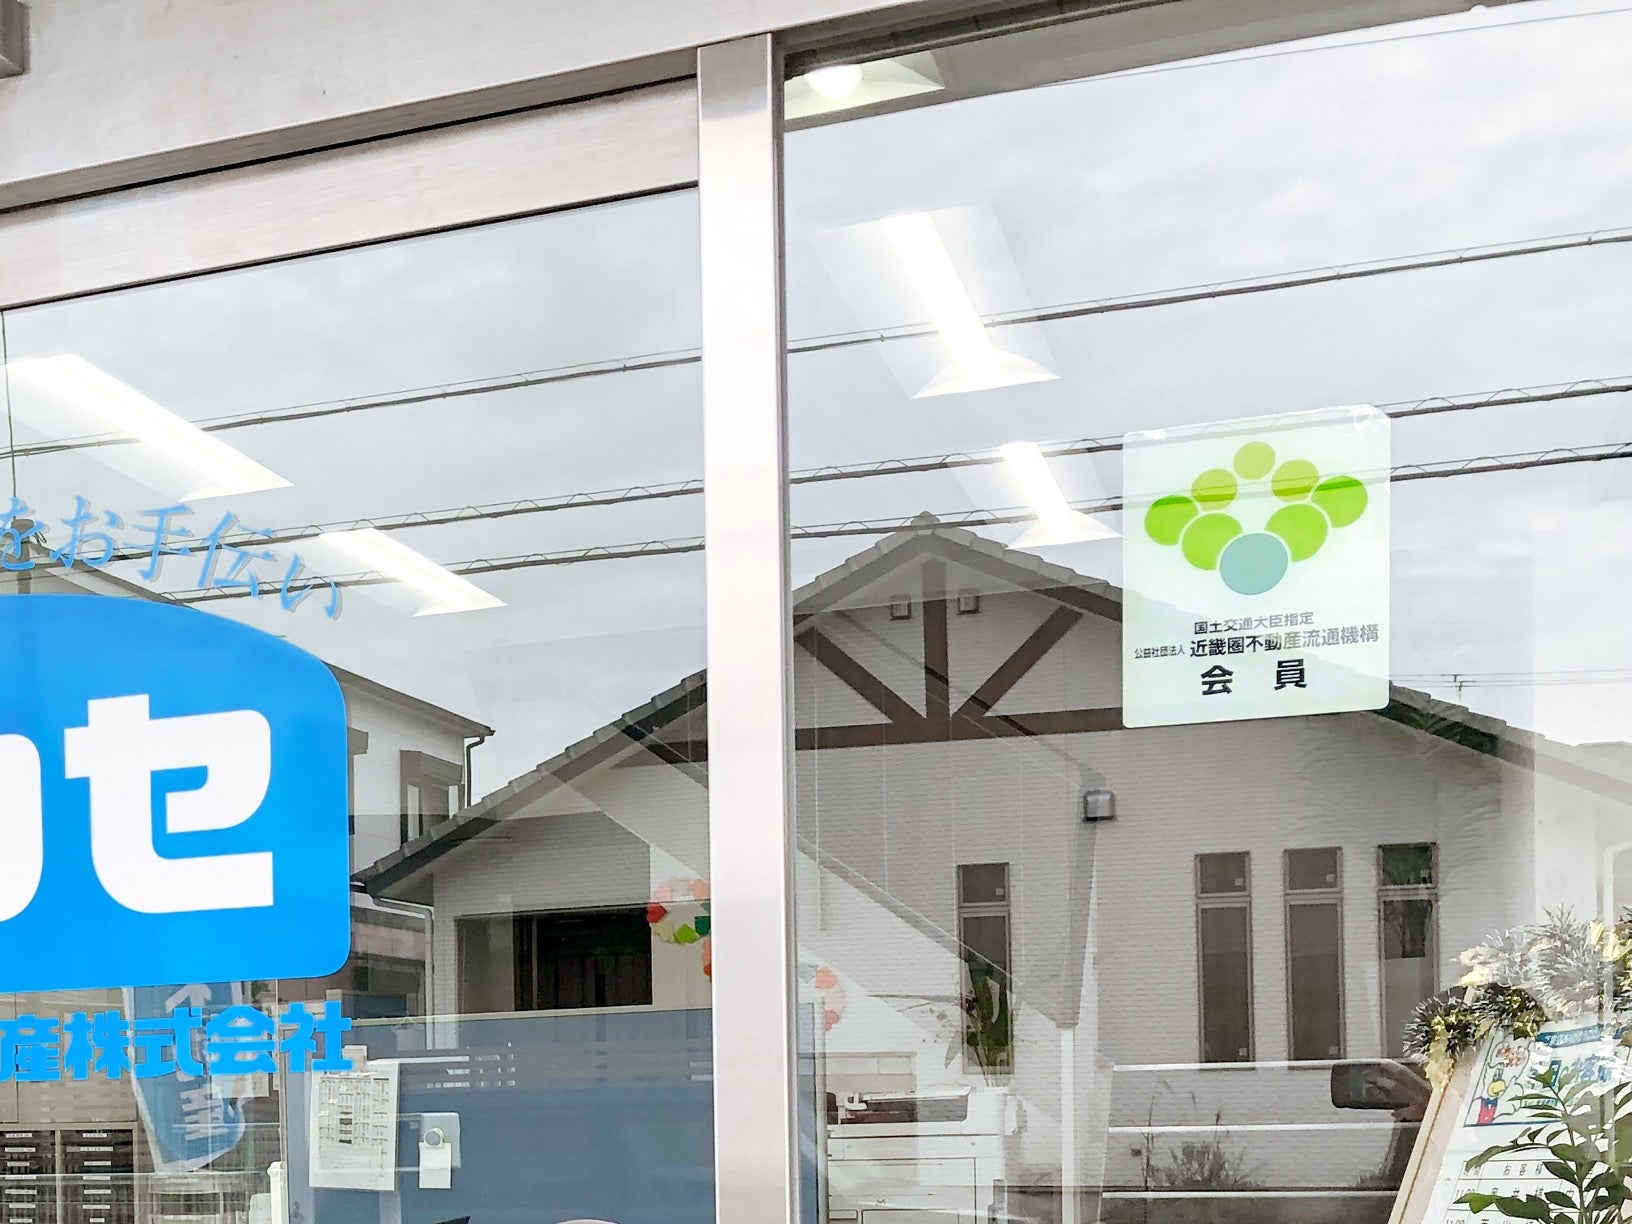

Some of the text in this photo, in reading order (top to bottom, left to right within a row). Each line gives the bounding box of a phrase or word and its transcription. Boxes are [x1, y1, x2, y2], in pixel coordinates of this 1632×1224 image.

[1194, 611, 1314, 634] 国土交通大臣指定
[1190, 624, 1379, 658] 近畿圏不動産流通機構
